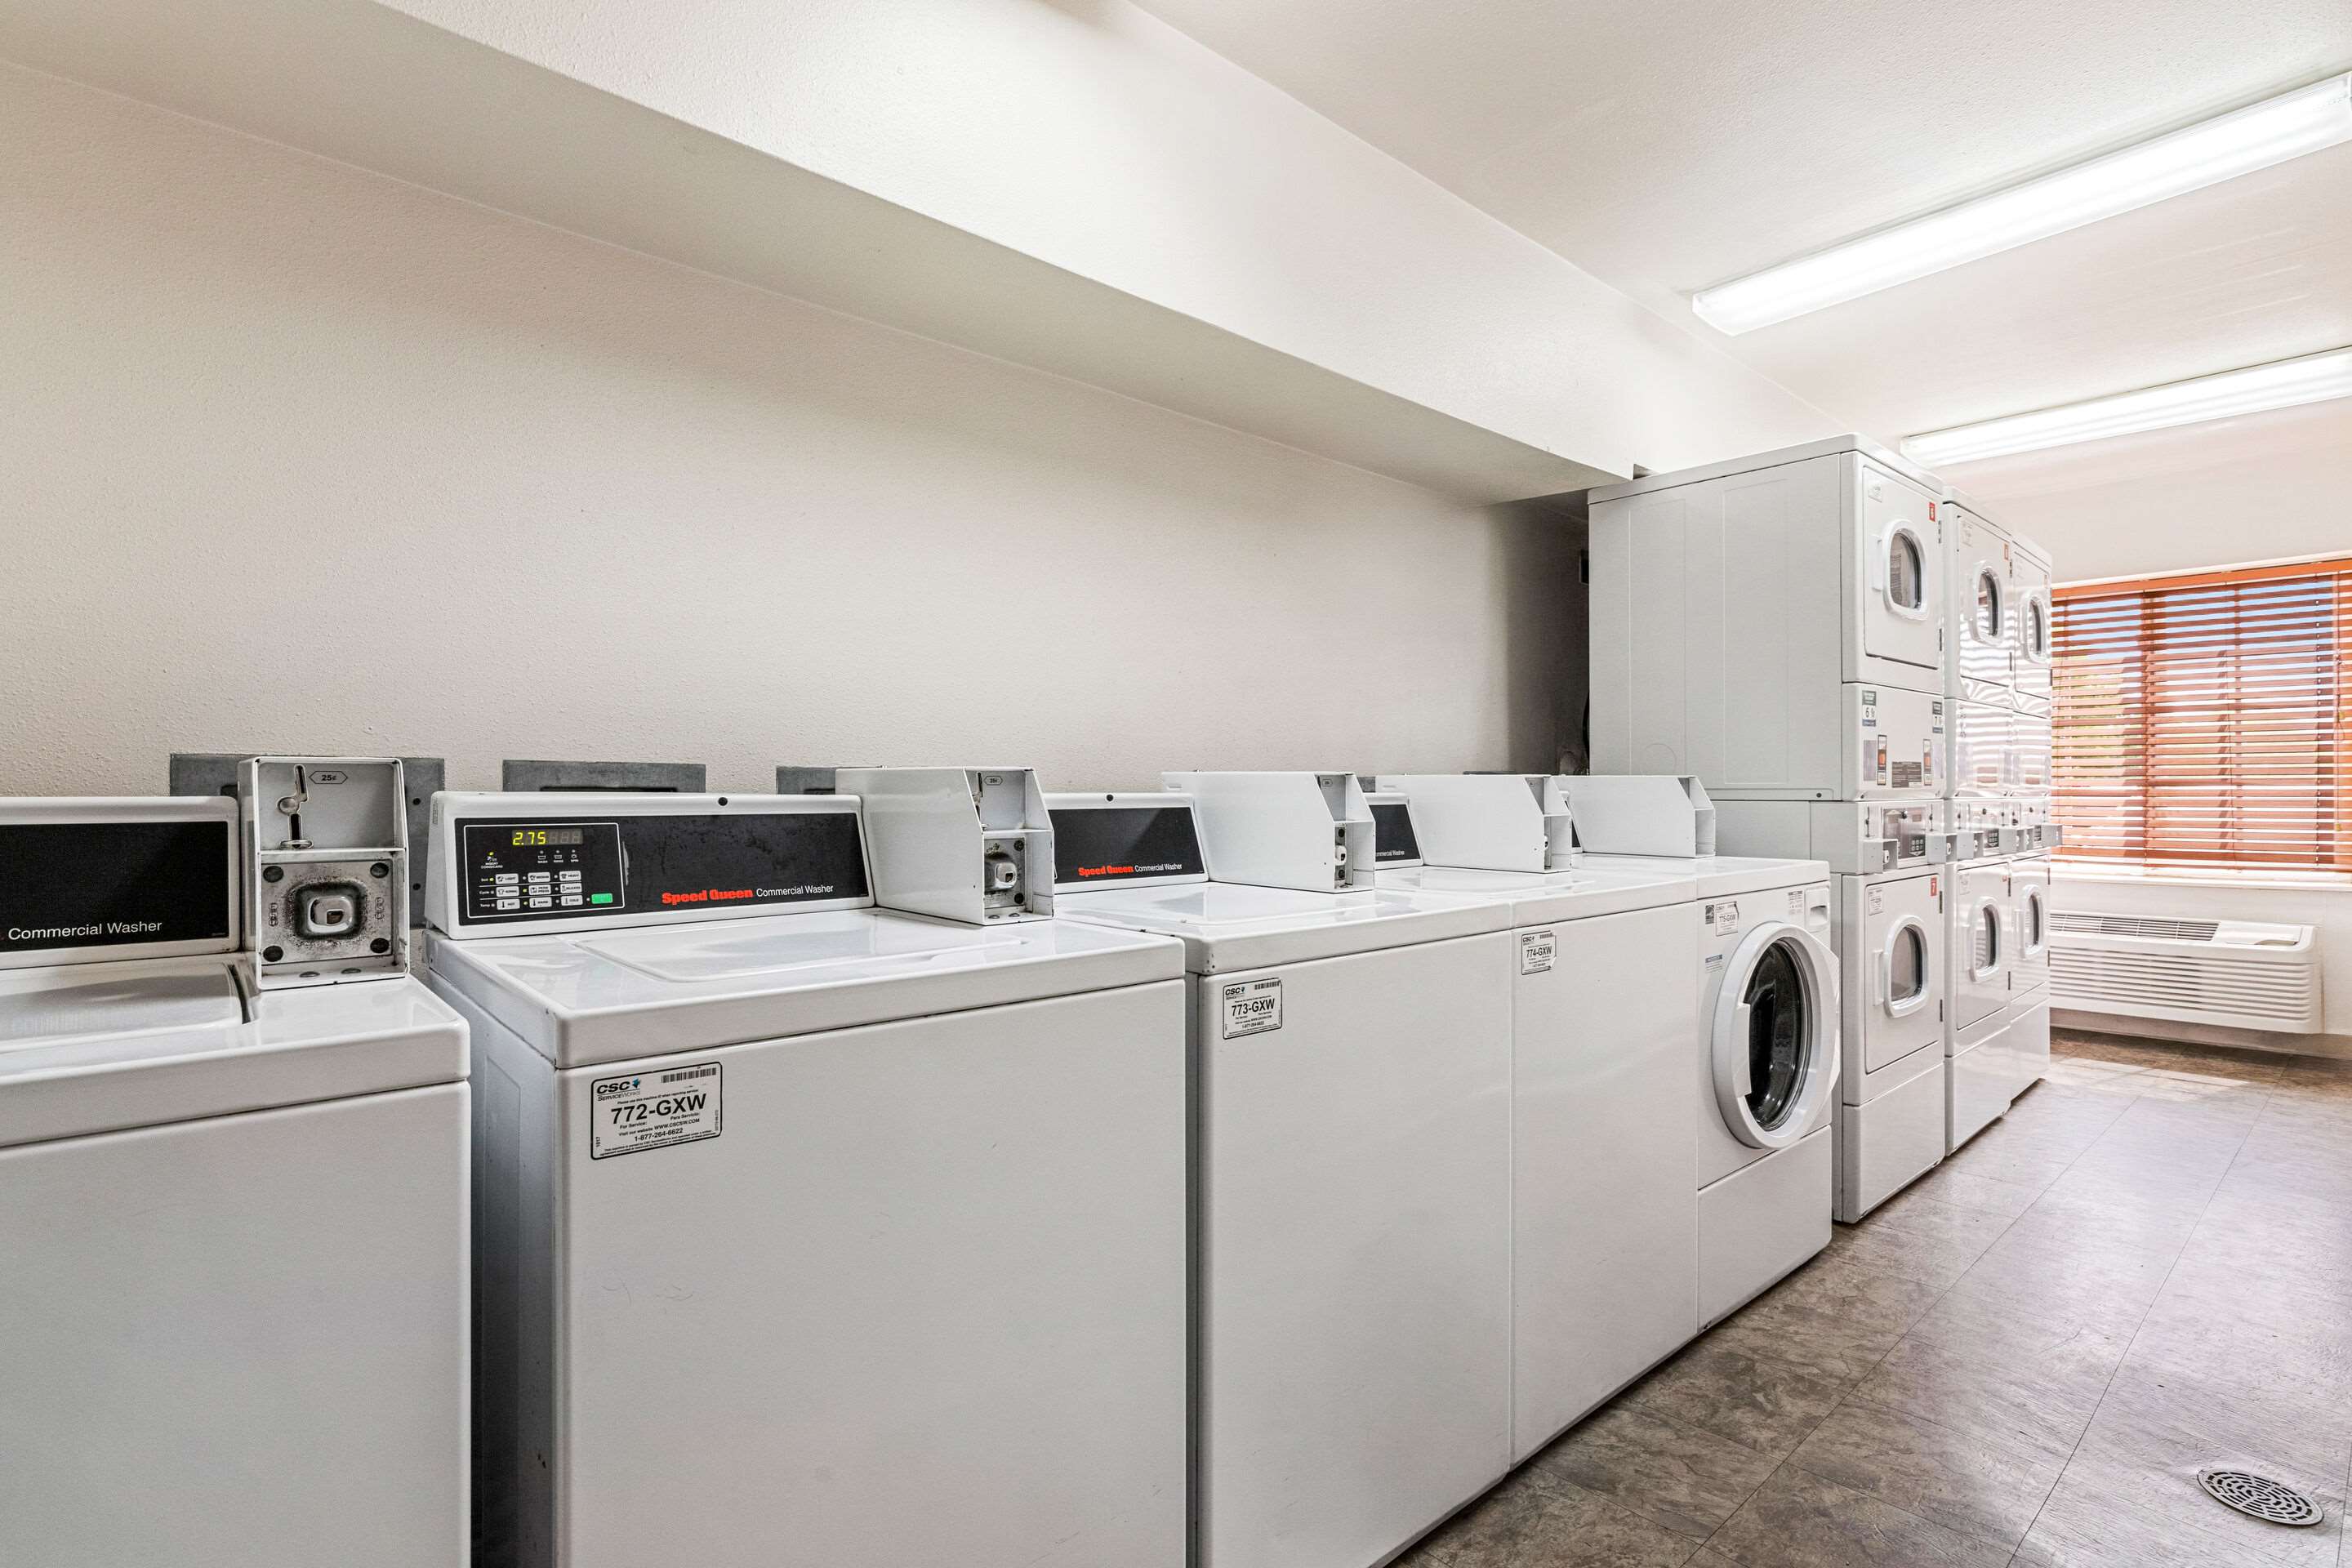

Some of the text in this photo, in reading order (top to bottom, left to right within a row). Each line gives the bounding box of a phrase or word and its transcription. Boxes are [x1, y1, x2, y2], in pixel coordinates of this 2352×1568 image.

[512, 831, 546, 846] 2.75
[1078, 866, 1107, 877] Speed
[1107, 864, 1134, 874] Queen
[662, 884, 834, 905] Speed Queen Commercial Washer
[8, 920, 163, 940] Commercial Washer
[1526, 946, 1552, 959] 774-GXW
[1225, 987, 1241, 996] CSC
[1231, 998, 1276, 1017] 773-GXW
[597, 1081, 630, 1094] CSC
[611, 1094, 707, 1125] 772-GXW
[635, 1128, 684, 1142] 1-877-264-6622
